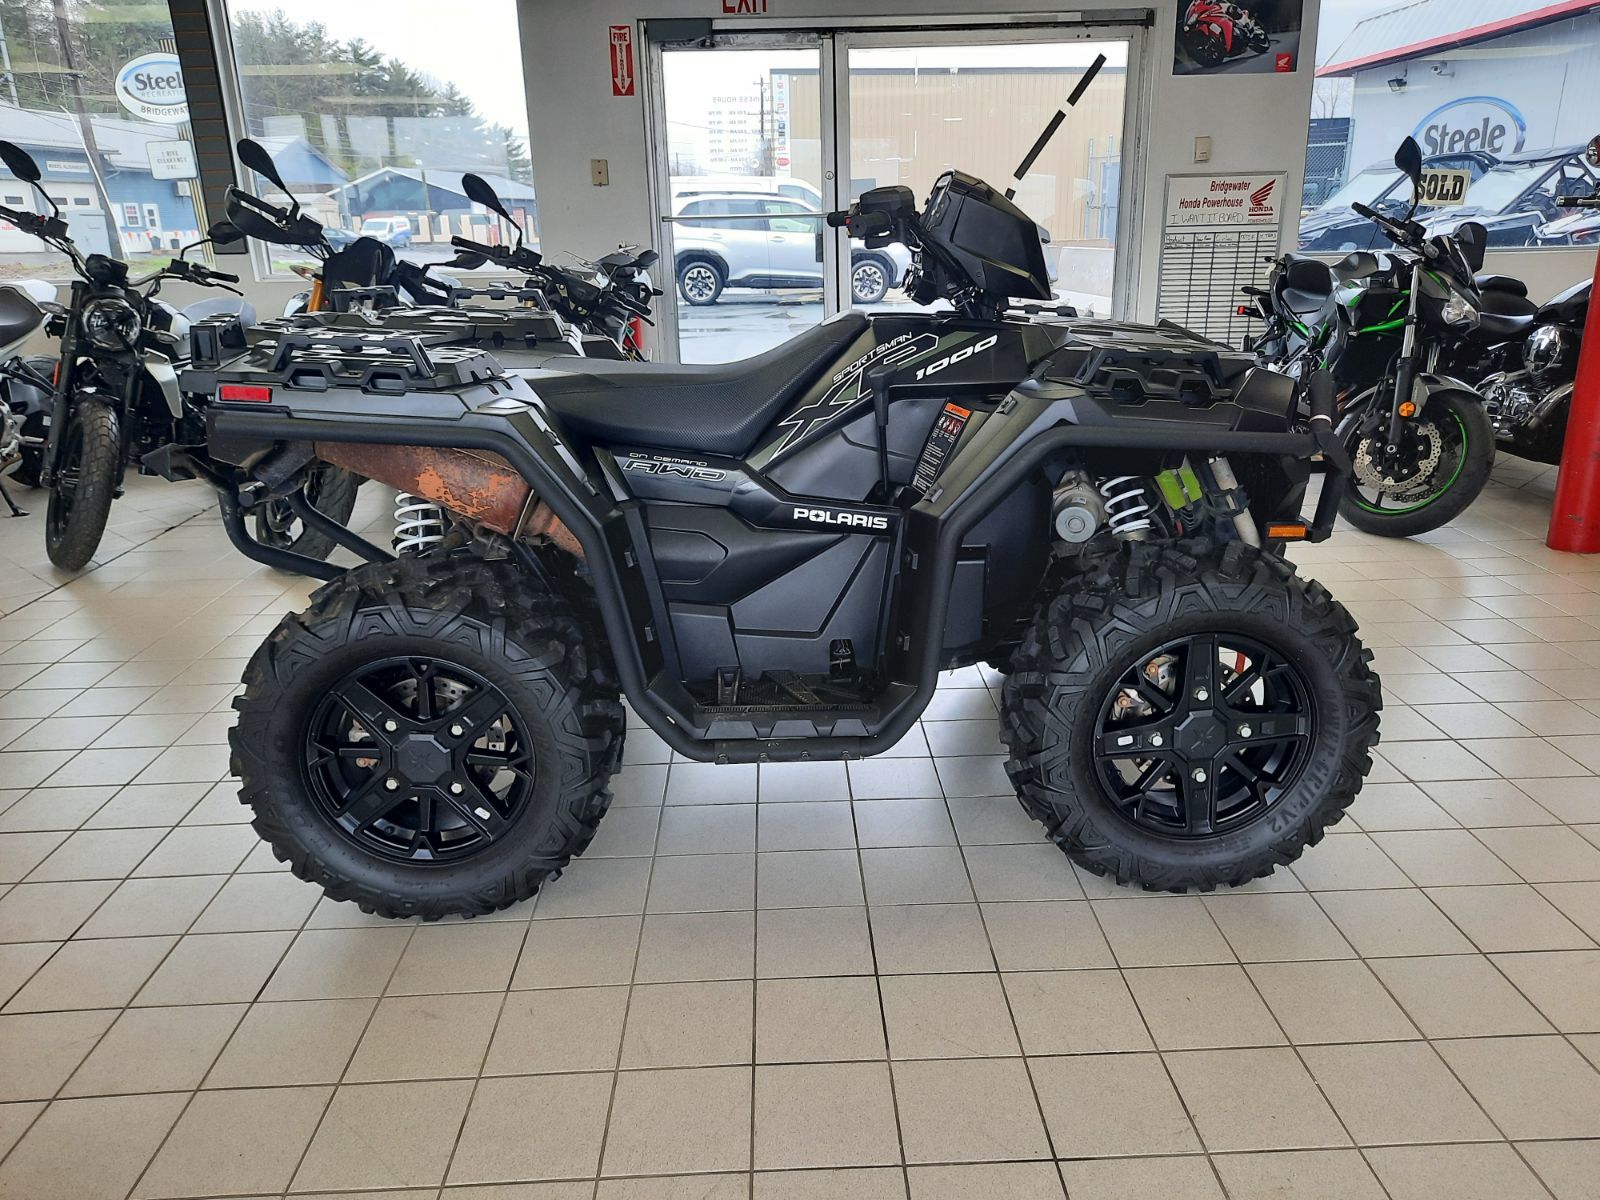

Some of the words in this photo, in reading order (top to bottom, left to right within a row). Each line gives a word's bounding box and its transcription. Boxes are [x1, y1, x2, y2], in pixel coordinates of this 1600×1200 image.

[612, 32, 628, 42] FIRE
[134, 71, 184, 91] Steel
[1424, 116, 1506, 156] Steele
[1209, 180, 1251, 194] Bridgewater
[1415, 173, 1465, 202] SOLD
[1178, 197, 1201, 210] Honda
[1202, 196, 1244, 209] Powerhouse
[1248, 205, 1274, 213] HONDA
[832, 331, 913, 384] SPORTSMAN
[915, 334, 999, 381] 1000
[622, 458, 727, 482] AWD
[792, 506, 888, 529] POLARIS
